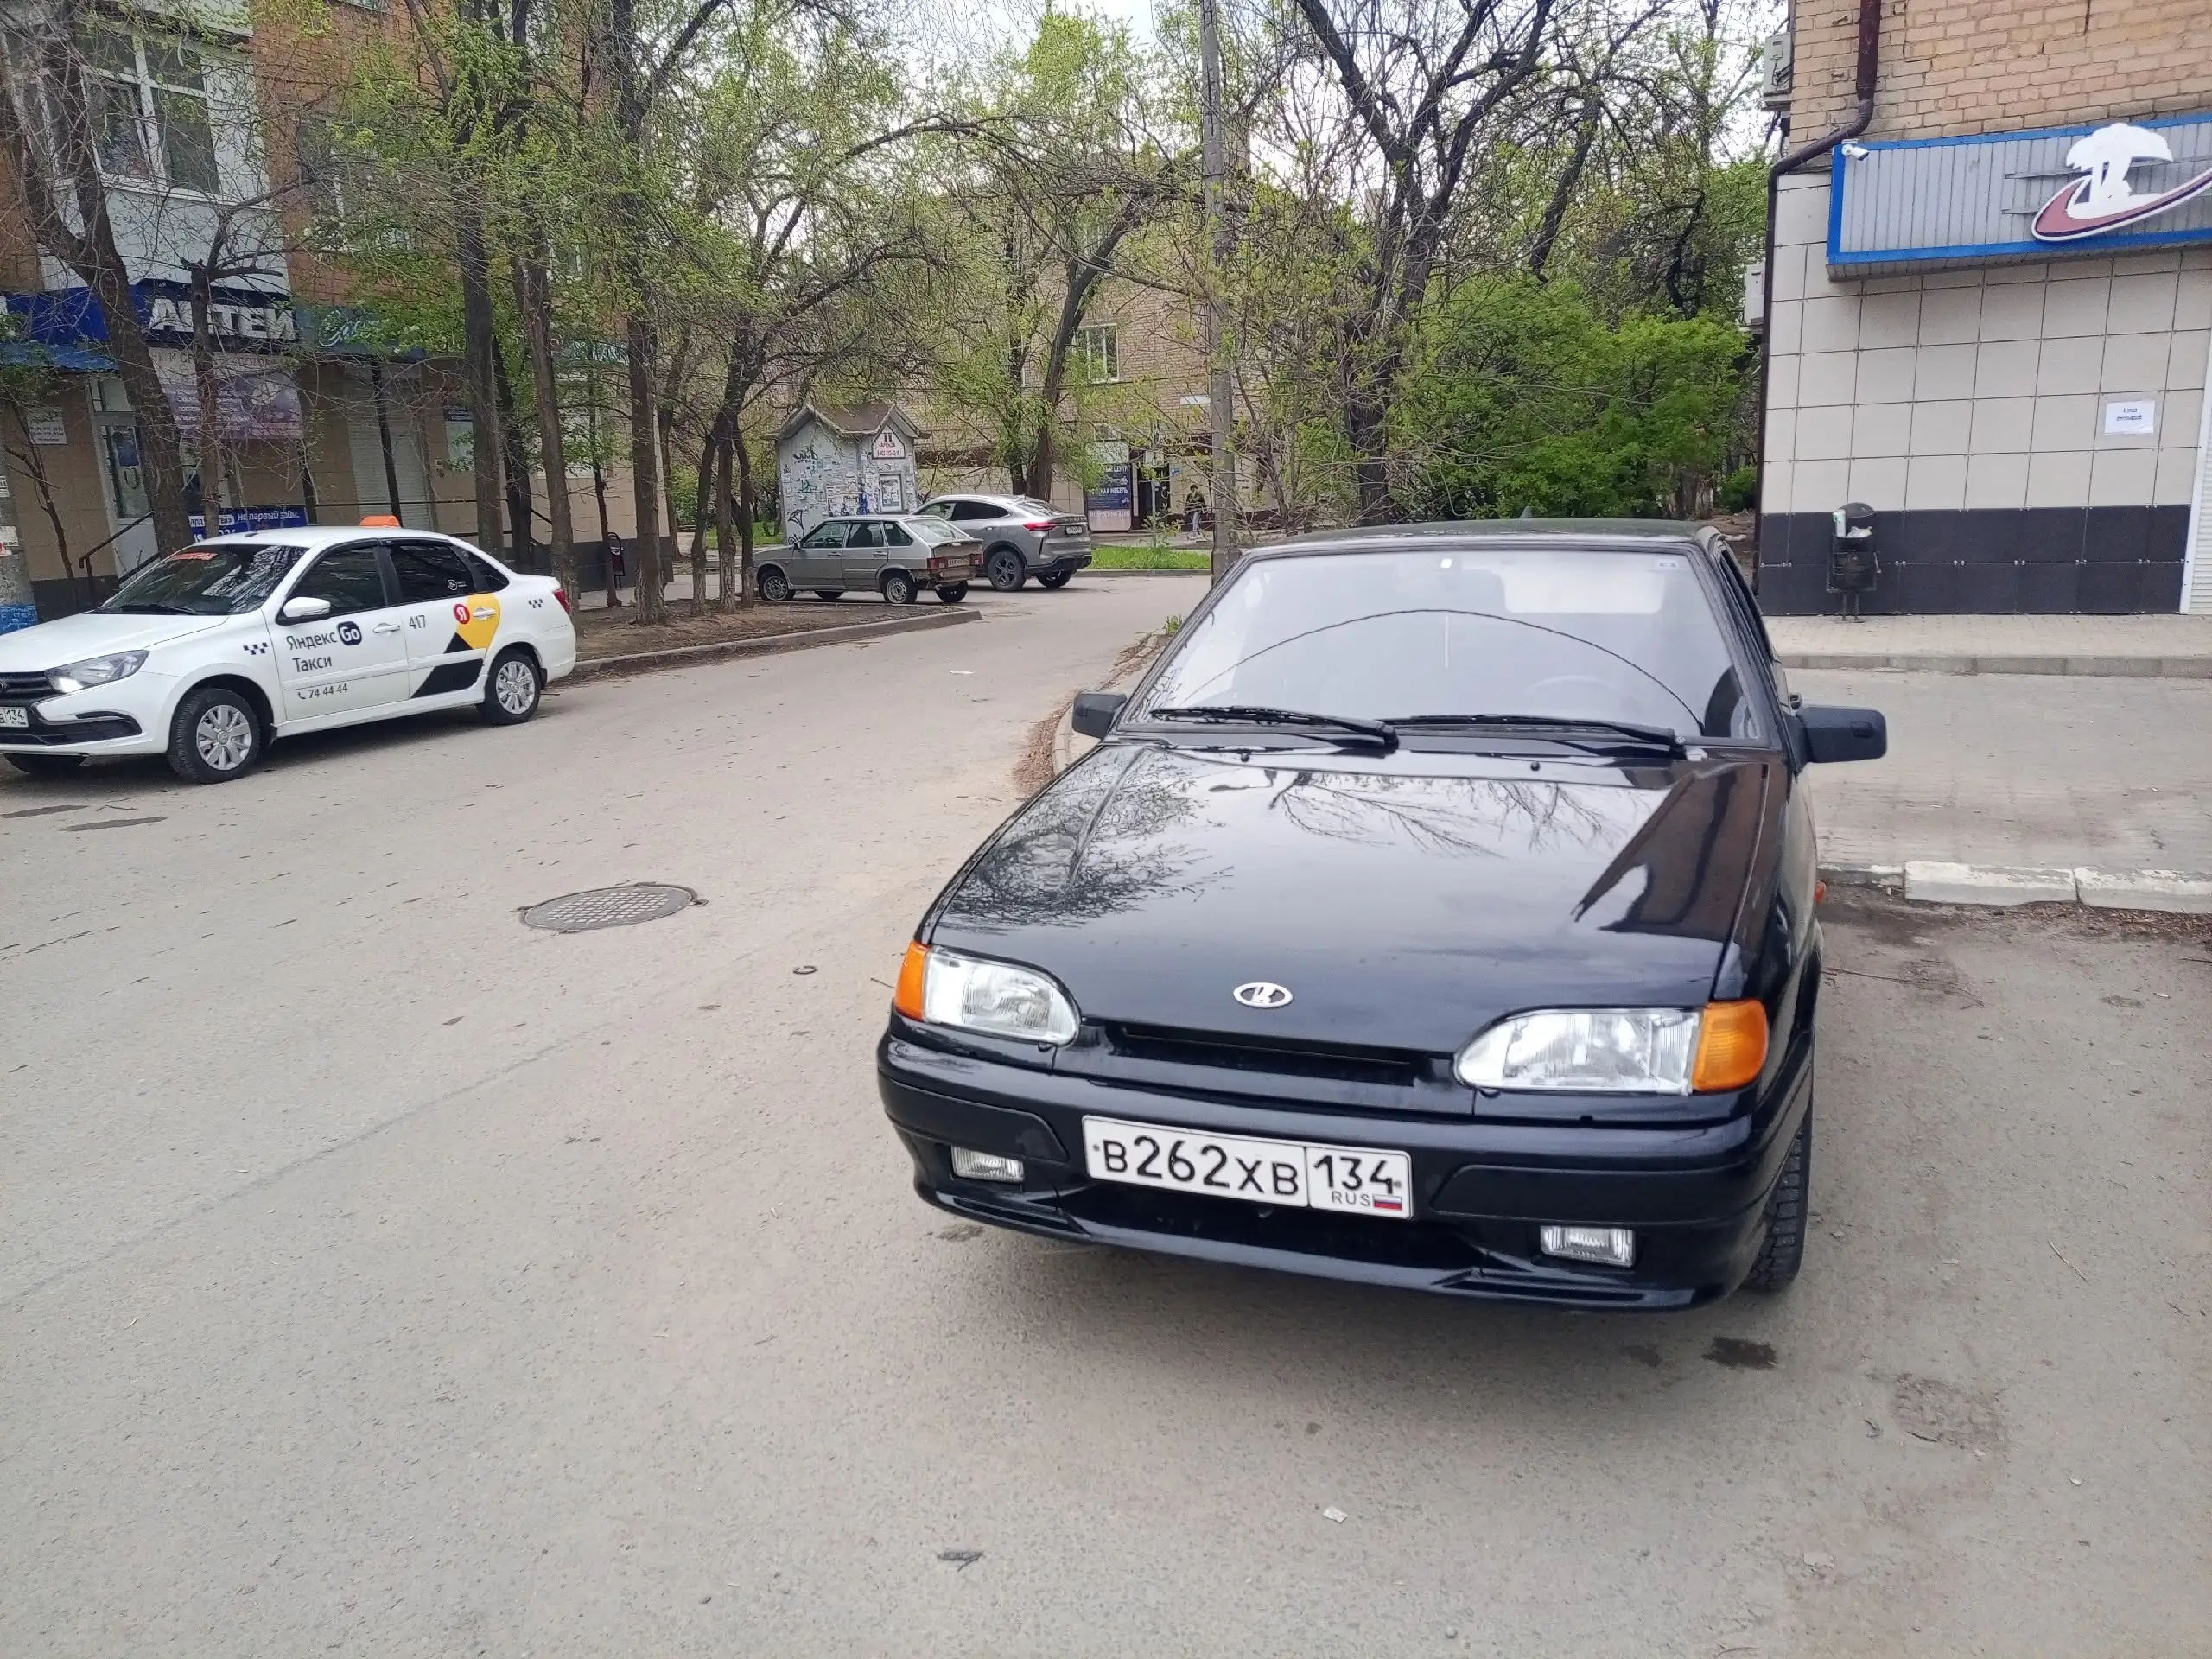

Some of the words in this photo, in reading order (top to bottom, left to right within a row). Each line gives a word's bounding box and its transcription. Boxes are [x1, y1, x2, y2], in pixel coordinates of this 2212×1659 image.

[409, 614, 426, 629] 417
[286, 631, 338, 651] Яндекс
[340, 626, 360, 642] Go
[292, 655, 332, 673] Такси
[308, 688, 320, 698] 74
[322, 686, 334, 696] 44
[336, 683, 348, 693] 44
[6, 709, 24, 721] 134
[1103, 1135, 1300, 1197] В262ХВ
[1313, 1155, 1395, 1195] 134
[1332, 1191, 1372, 1207] RUS
